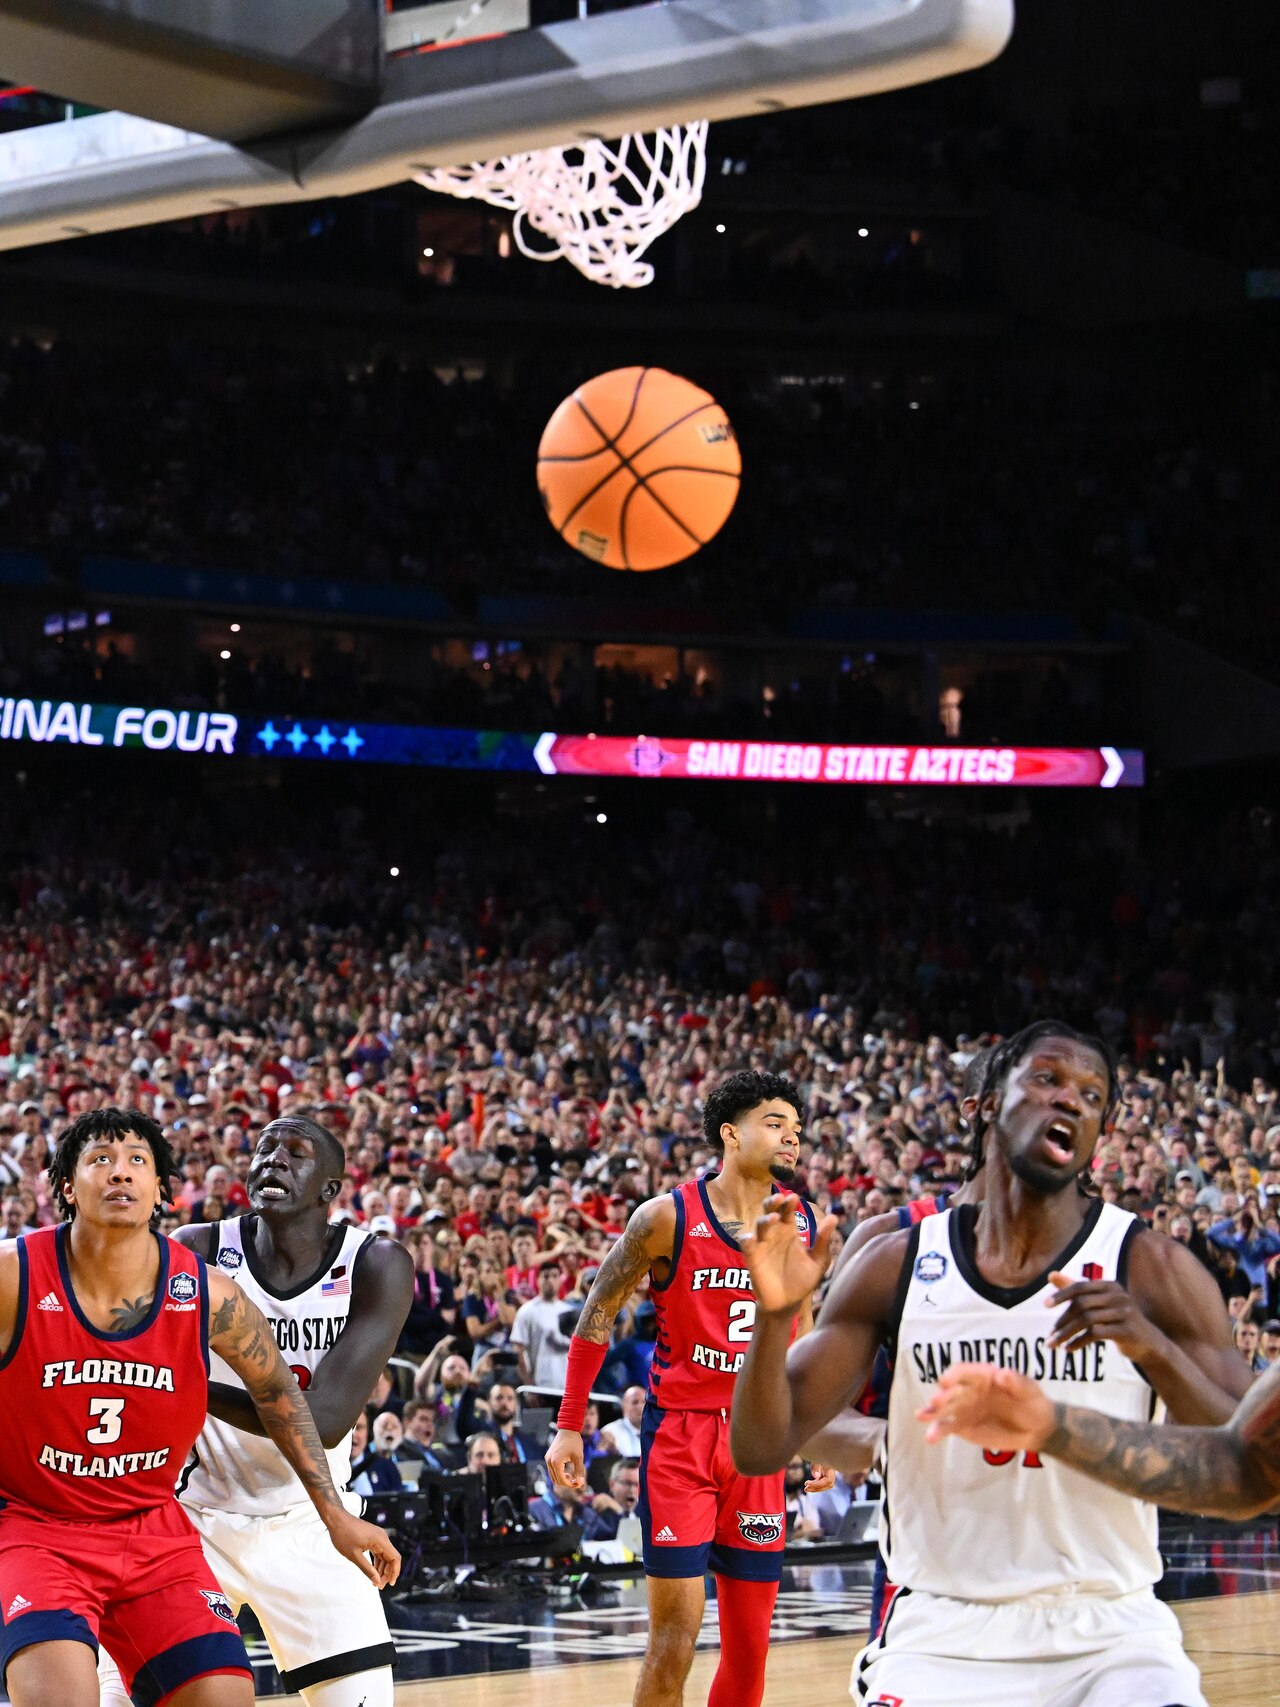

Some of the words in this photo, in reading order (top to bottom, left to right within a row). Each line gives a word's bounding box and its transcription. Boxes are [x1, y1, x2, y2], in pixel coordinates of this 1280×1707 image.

[113, 707, 238, 754] FOUR
[686, 741, 741, 777] SAN
[743, 743, 822, 780] DIEGO
[824, 746, 909, 782] STATE
[909, 748, 1016, 783] AZTECS
[689, 1230, 712, 1238] adidas
[36, 1303, 64, 1312] adidas
[728, 1300, 756, 1342] 2
[42, 1359, 175, 1392] FLORIDA
[86, 1397, 125, 1445] 3
[39, 1444, 170, 1478] ATLANTIC
[744, 1514, 782, 1527] FAU
